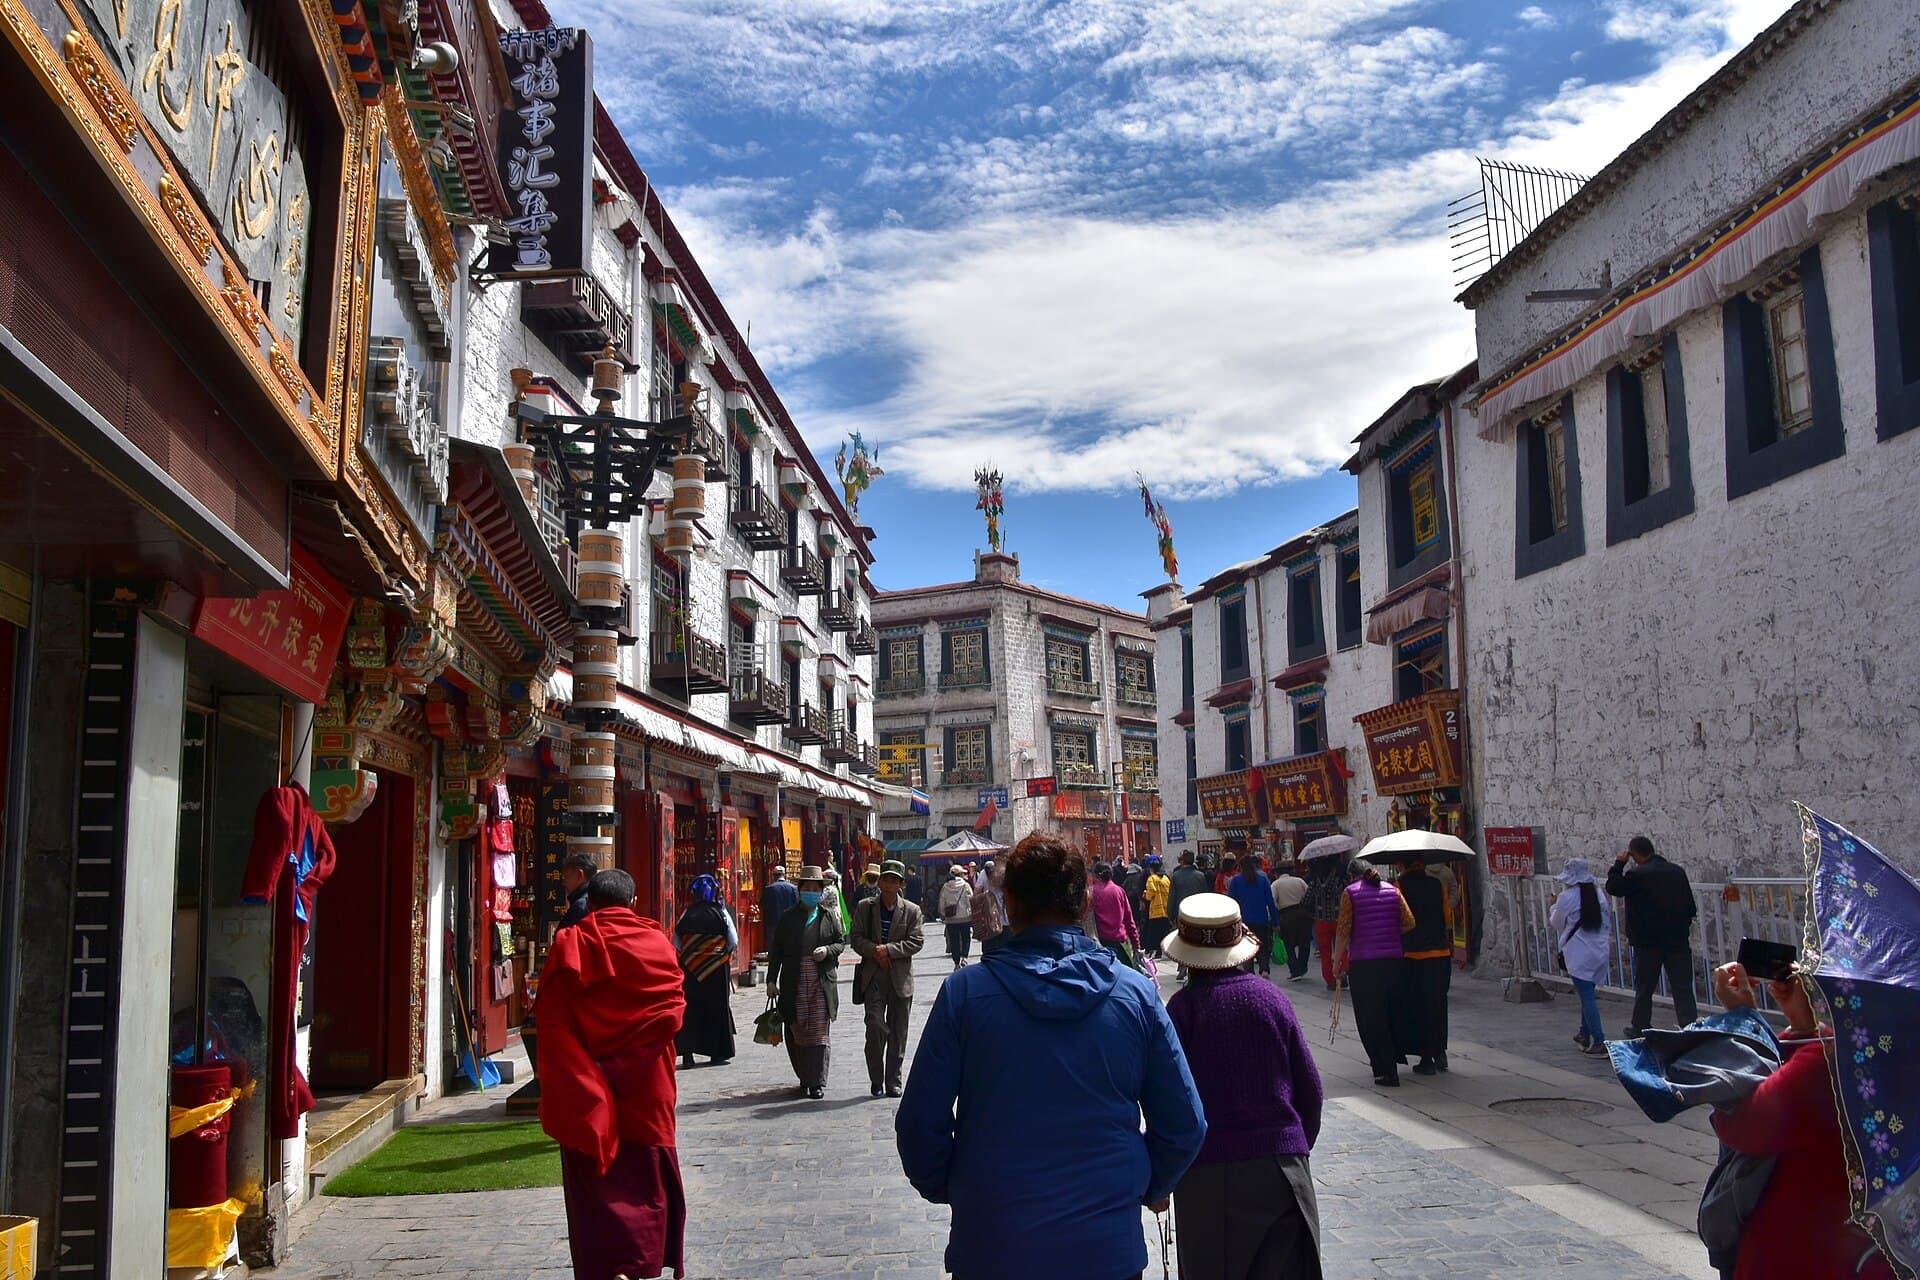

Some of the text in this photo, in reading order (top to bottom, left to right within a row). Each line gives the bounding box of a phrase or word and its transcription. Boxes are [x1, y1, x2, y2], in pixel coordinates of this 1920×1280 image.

[508, 57, 560, 235] 诸事汇集
[1445, 710, 1459, 740] 2号
